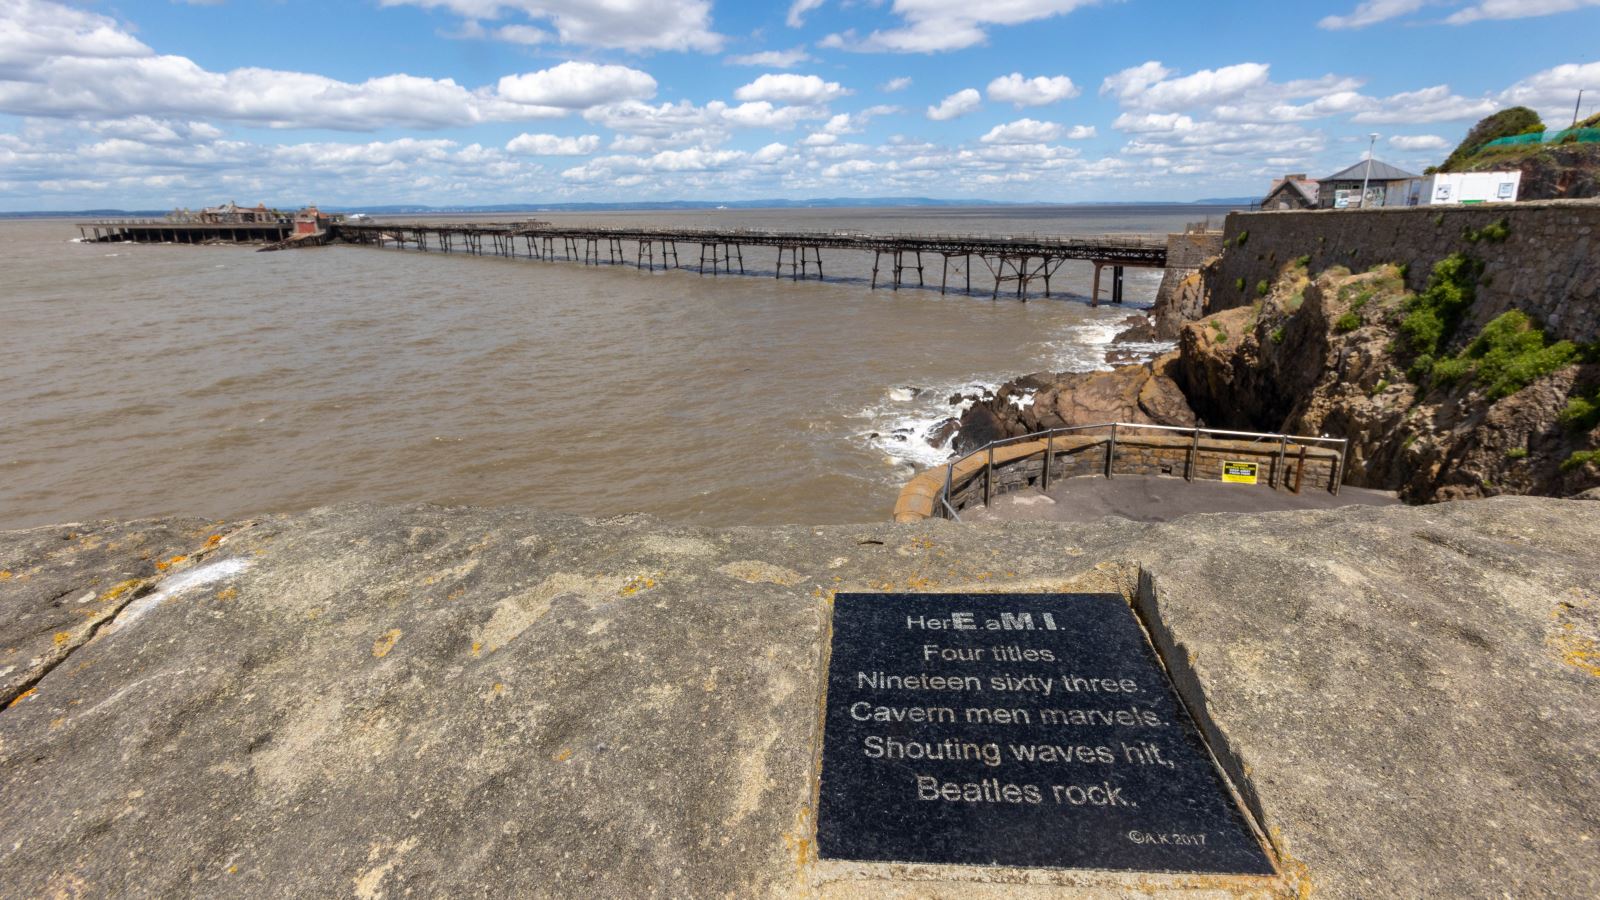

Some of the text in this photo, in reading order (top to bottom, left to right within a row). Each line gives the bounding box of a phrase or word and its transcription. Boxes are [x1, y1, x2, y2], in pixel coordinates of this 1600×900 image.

[923, 645, 985, 661] Four
[857, 671, 1147, 695] Nineteen sixty three.
[850, 701, 1170, 727] Cavern men marvels.
[863, 736, 1176, 769] Shouting waves hit,
[916, 776, 1139, 808] Beatles rock.
